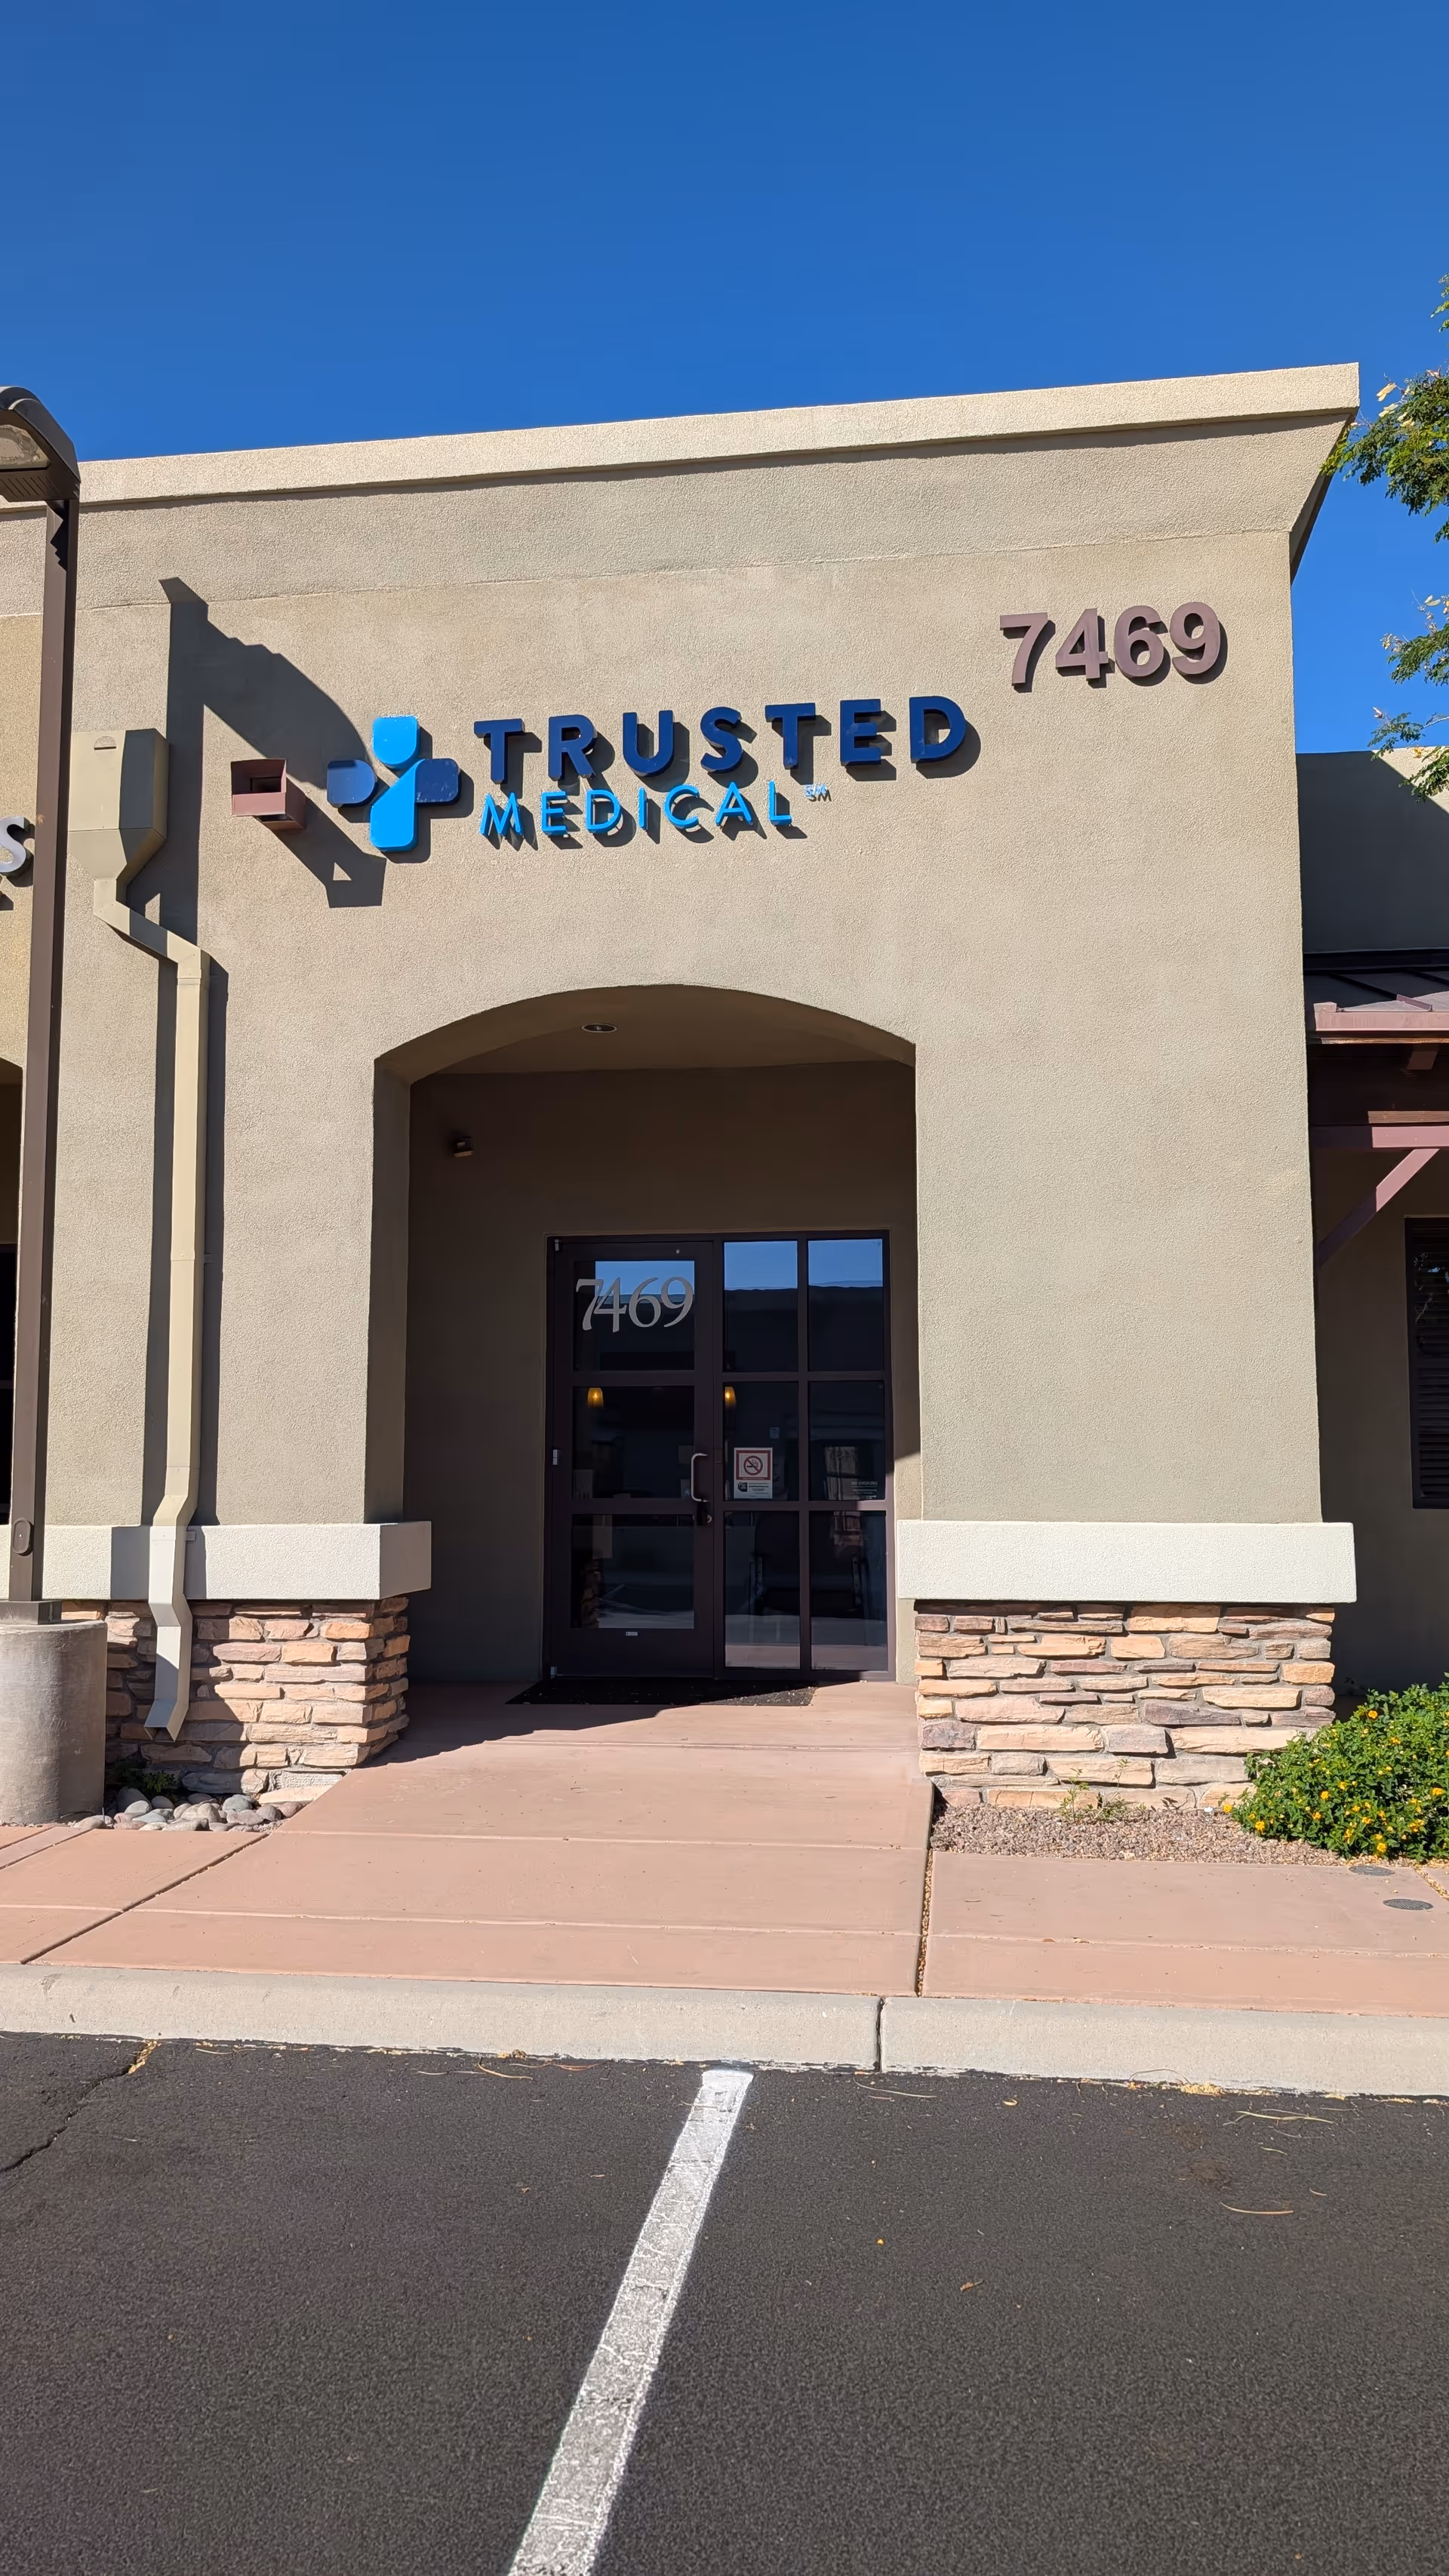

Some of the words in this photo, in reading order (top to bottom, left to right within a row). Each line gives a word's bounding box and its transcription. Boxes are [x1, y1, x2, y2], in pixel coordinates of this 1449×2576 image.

[1000, 602, 1220, 686] 7469
[474, 695, 967, 785] TRUSTED
[480, 782, 793, 839] MEDICAL
[576, 1277, 694, 1332] 7469
